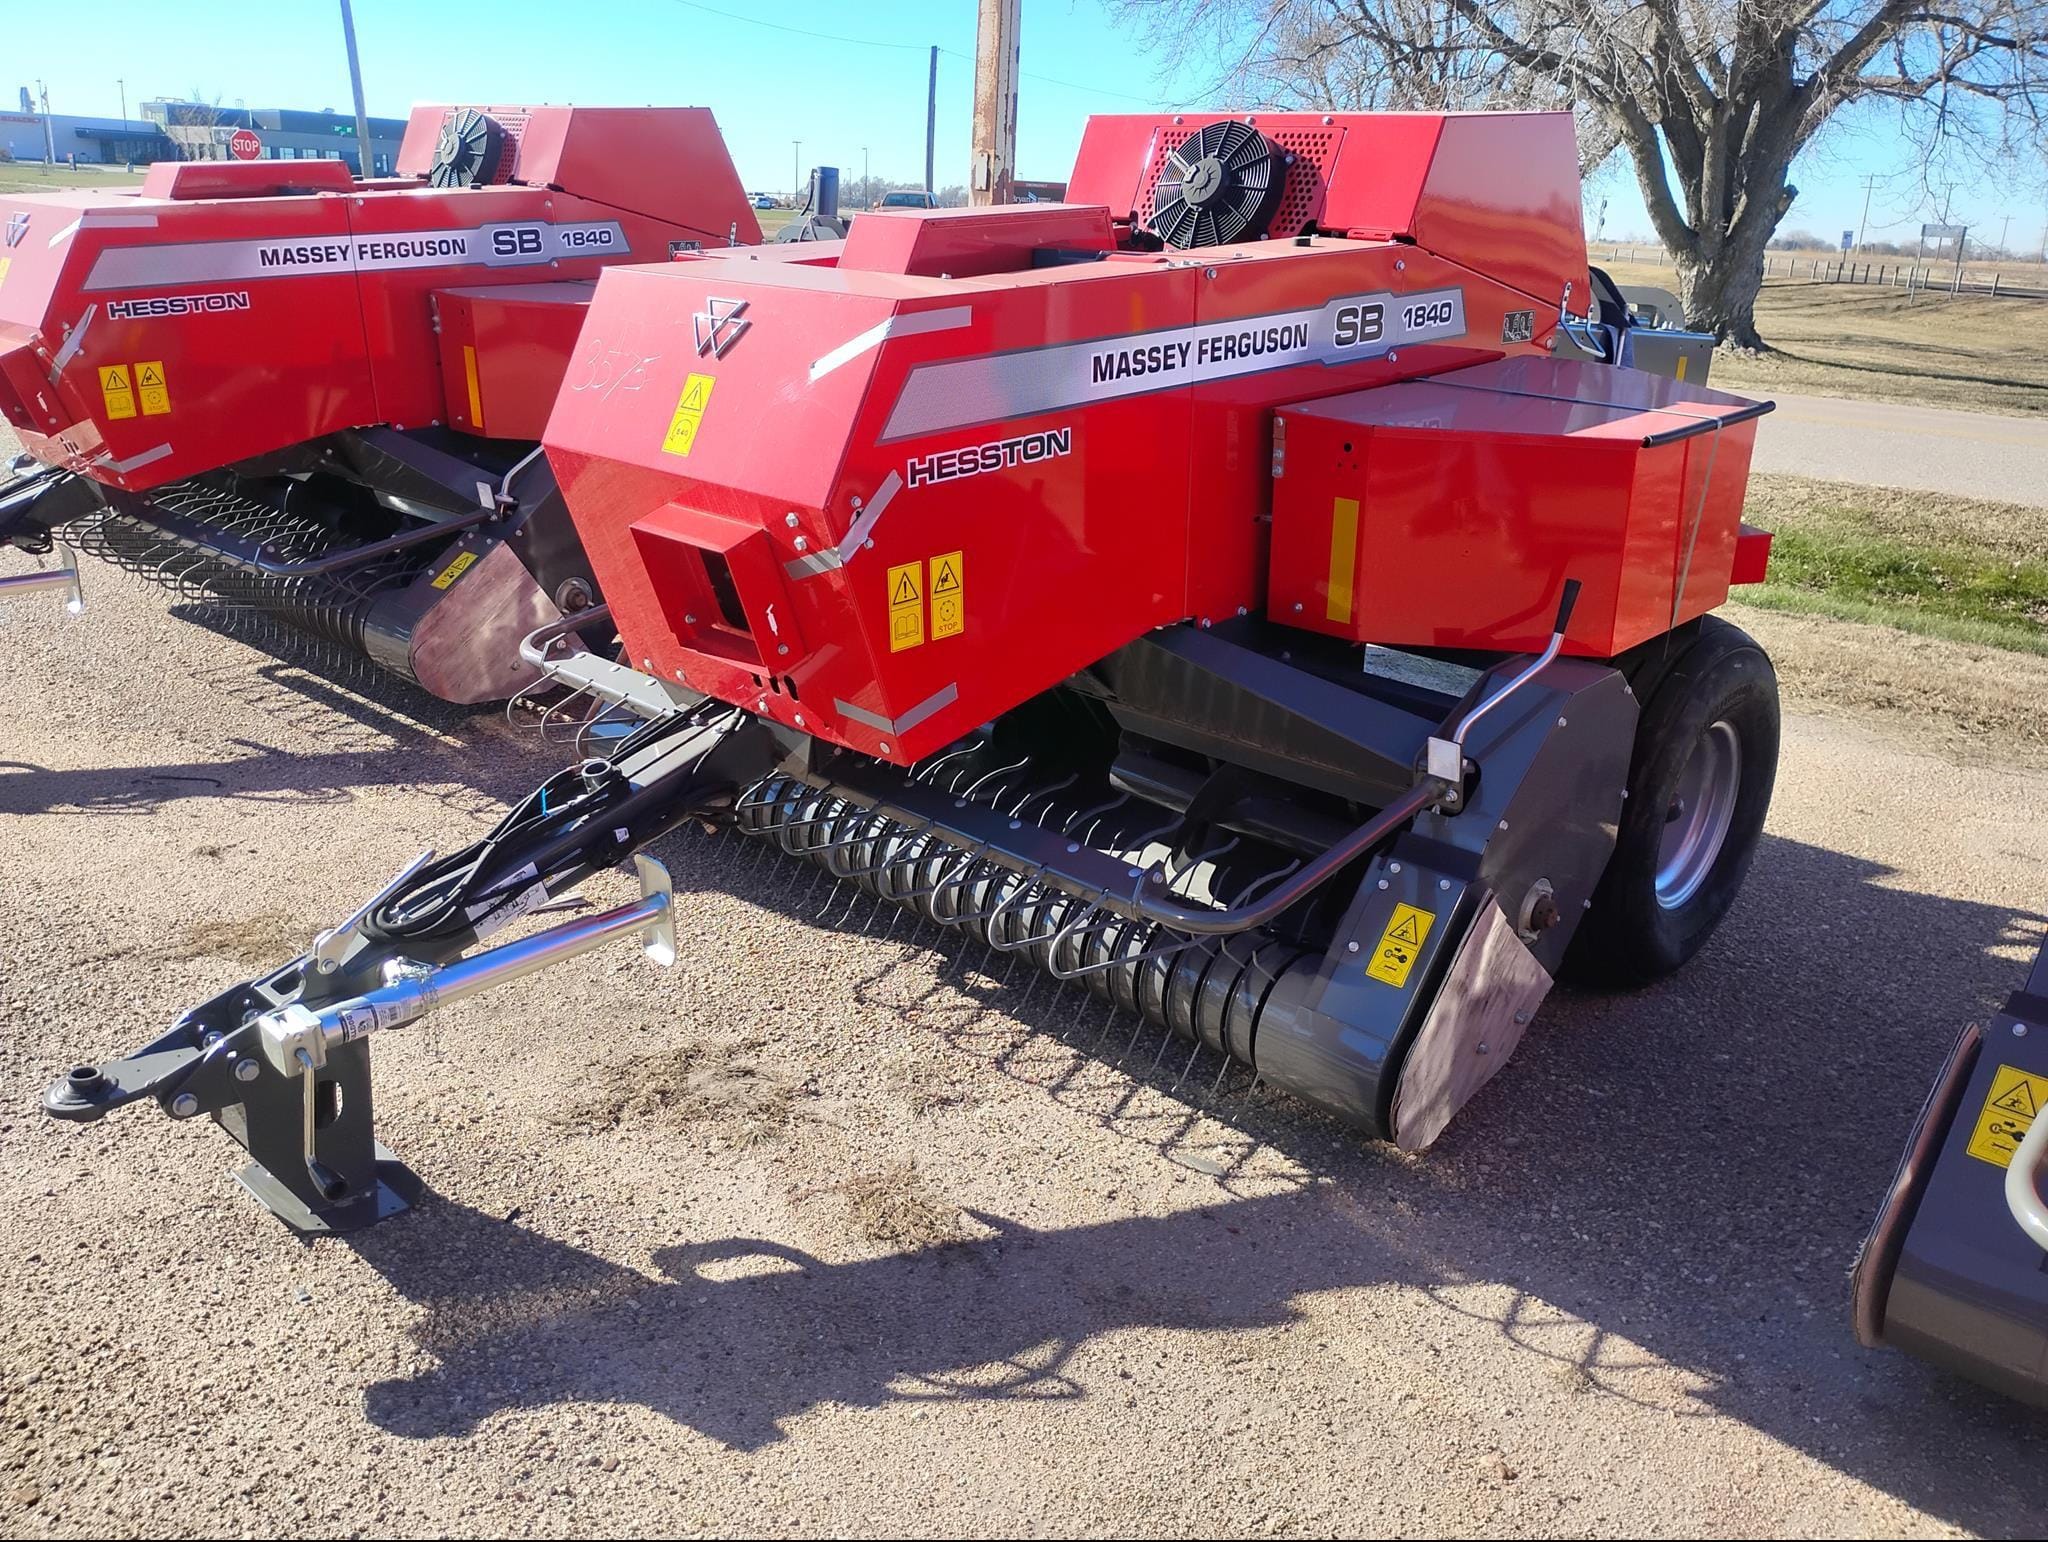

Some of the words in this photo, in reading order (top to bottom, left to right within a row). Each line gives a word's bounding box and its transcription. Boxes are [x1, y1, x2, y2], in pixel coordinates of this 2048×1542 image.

[233, 138, 259, 152] STOP
[259, 244, 351, 267] MASSEY
[358, 238, 467, 260] FERGUSON
[492, 228, 543, 256] SB
[561, 229, 613, 248] 1840
[107, 291, 250, 320] HESSTON
[1092, 341, 1192, 384] MASSEY
[1197, 323, 1309, 365] FERGUSON
[1333, 302, 1385, 349] SB
[1401, 300, 1454, 331] 1840
[907, 427, 1071, 488] HESSTON
[938, 621, 958, 633] STOP
